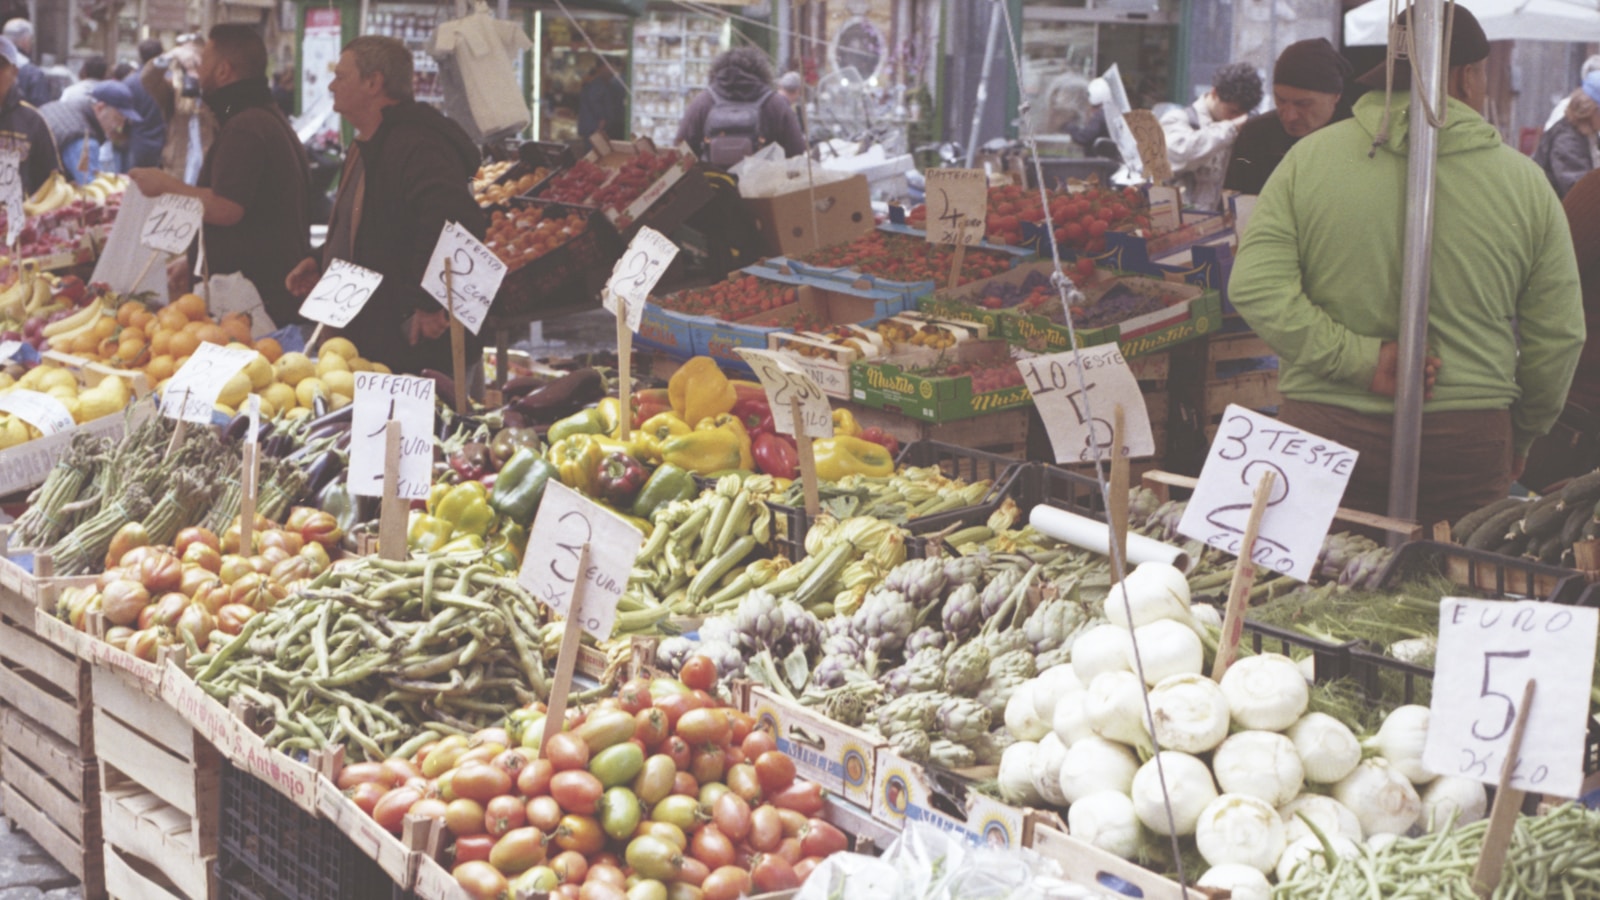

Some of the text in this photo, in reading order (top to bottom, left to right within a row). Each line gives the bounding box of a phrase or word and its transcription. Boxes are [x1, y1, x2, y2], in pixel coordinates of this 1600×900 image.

[939, 188, 965, 229] 4
[439, 248, 475, 302] 2
[1026, 360, 1067, 395] 10
[1066, 382, 1114, 448] 5
[1218, 415, 1353, 476] 3 TESTE
[1206, 460, 1291, 553] 2
[550, 511, 593, 583] 3
[1452, 603, 1573, 633] EURO
[1471, 649, 1531, 741] 5
